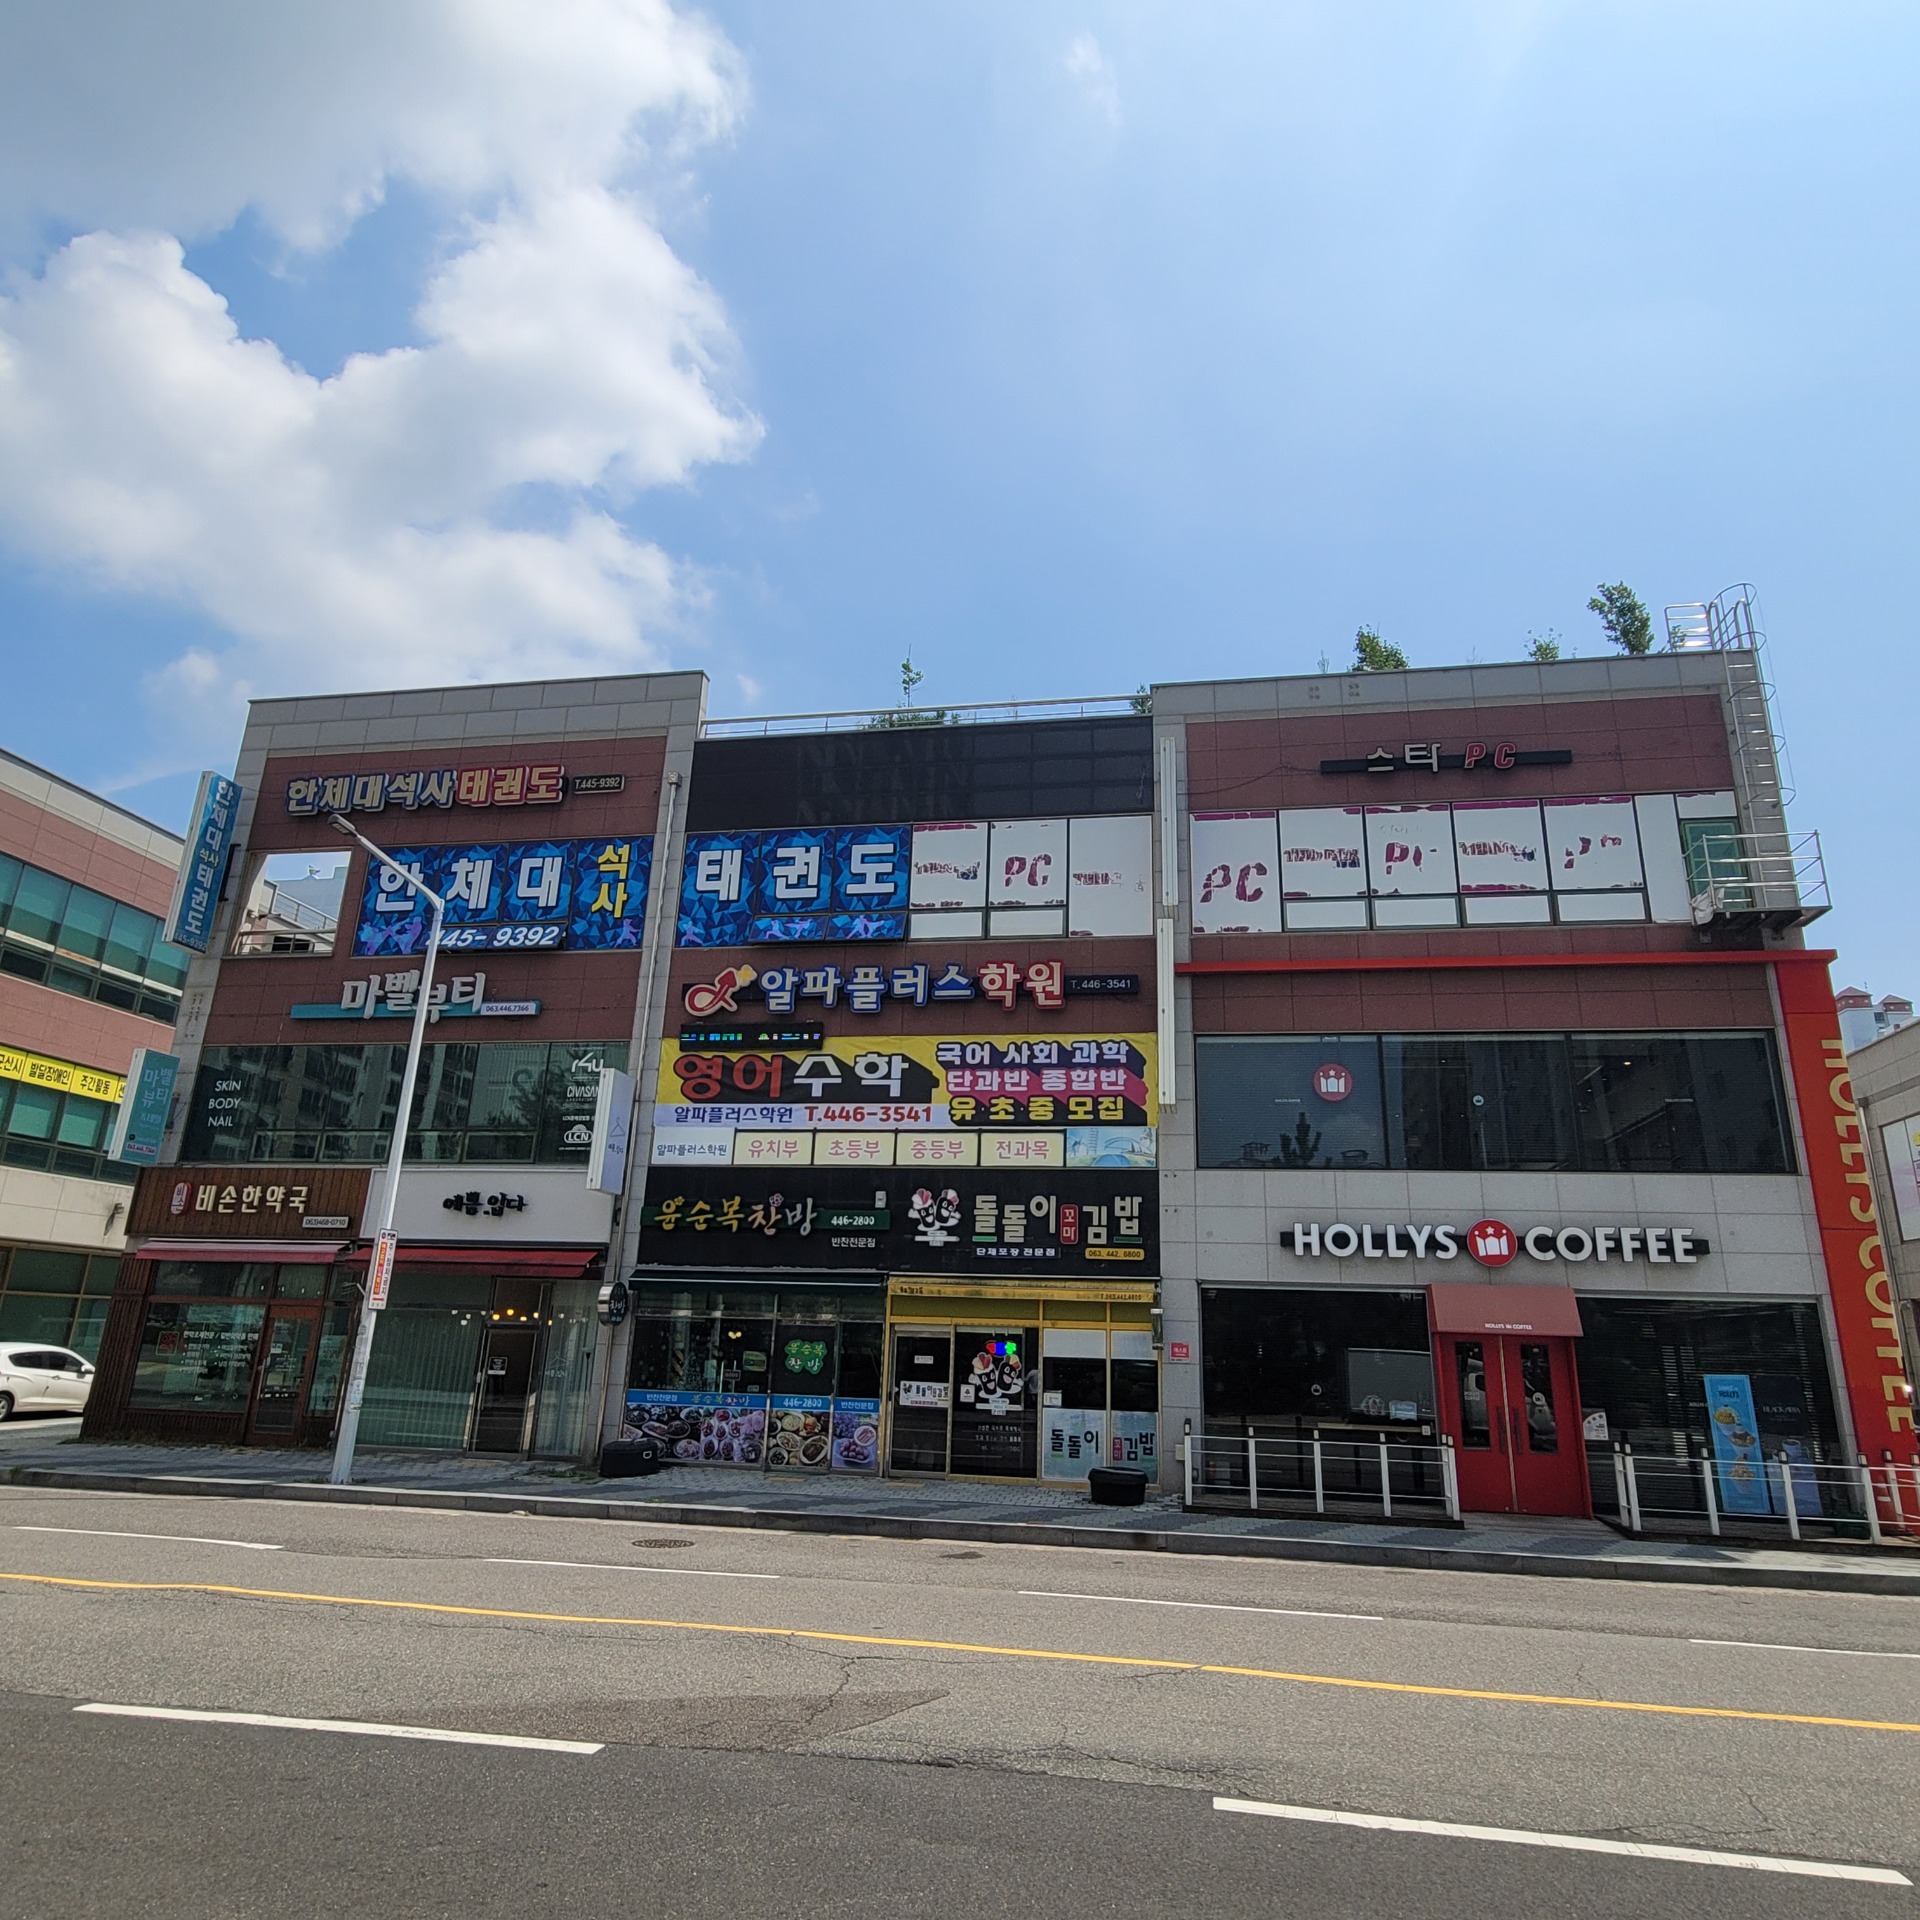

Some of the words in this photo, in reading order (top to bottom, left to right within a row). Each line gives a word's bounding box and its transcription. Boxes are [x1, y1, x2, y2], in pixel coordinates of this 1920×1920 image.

[1366, 744, 1440, 772] 스타
[1464, 742, 1516, 769] PC
[592, 843, 631, 919] 석사
[696, 843, 895, 901] 태권도
[375, 856, 563, 912] 한체대
[493, 926, 560, 946] 9392
[938, 1043, 996, 1065] 국어
[1003, 1042, 1059, 1065] 사회
[1072, 1040, 1129, 1064] 과학
[215, 1080, 241, 1092] SKIN
[947, 1069, 1029, 1092] 단과반
[1042, 1068, 1127, 1092] 종합반
[208, 1098, 240, 1109] BODY
[1069, 1096, 1125, 1120] 모집
[208, 1115, 233, 1127] NAIL
[675, 1106, 793, 1124] 알파플러스학원
[805, 1106, 932, 1122] T.446-3541
[568, 1132, 589, 1140] LCN
[657, 1142, 727, 1158] 알파플러스학원
[748, 1141, 799, 1159] 유치부
[828, 1140, 880, 1159] 초등부
[910, 1138, 965, 1160] 중등부
[996, 1138, 1050, 1160] 전과목
[195, 1184, 309, 1214] 비손한약국
[831, 1215, 875, 1226] 446-2800
[973, 1195, 1057, 1243] 돌돌이
[1082, 1196, 1142, 1245] 김밥
[831, 1236, 876, 1248] 반찬전문점
[1024, 1248, 1056, 1257] 전문점
[1293, 1222, 1458, 1259] HOLLYS
[1525, 1226, 1697, 1264] COFFEE
[1050, 1428, 1099, 1459] 돌돌이
[1123, 1431, 1155, 1461] 김밥
